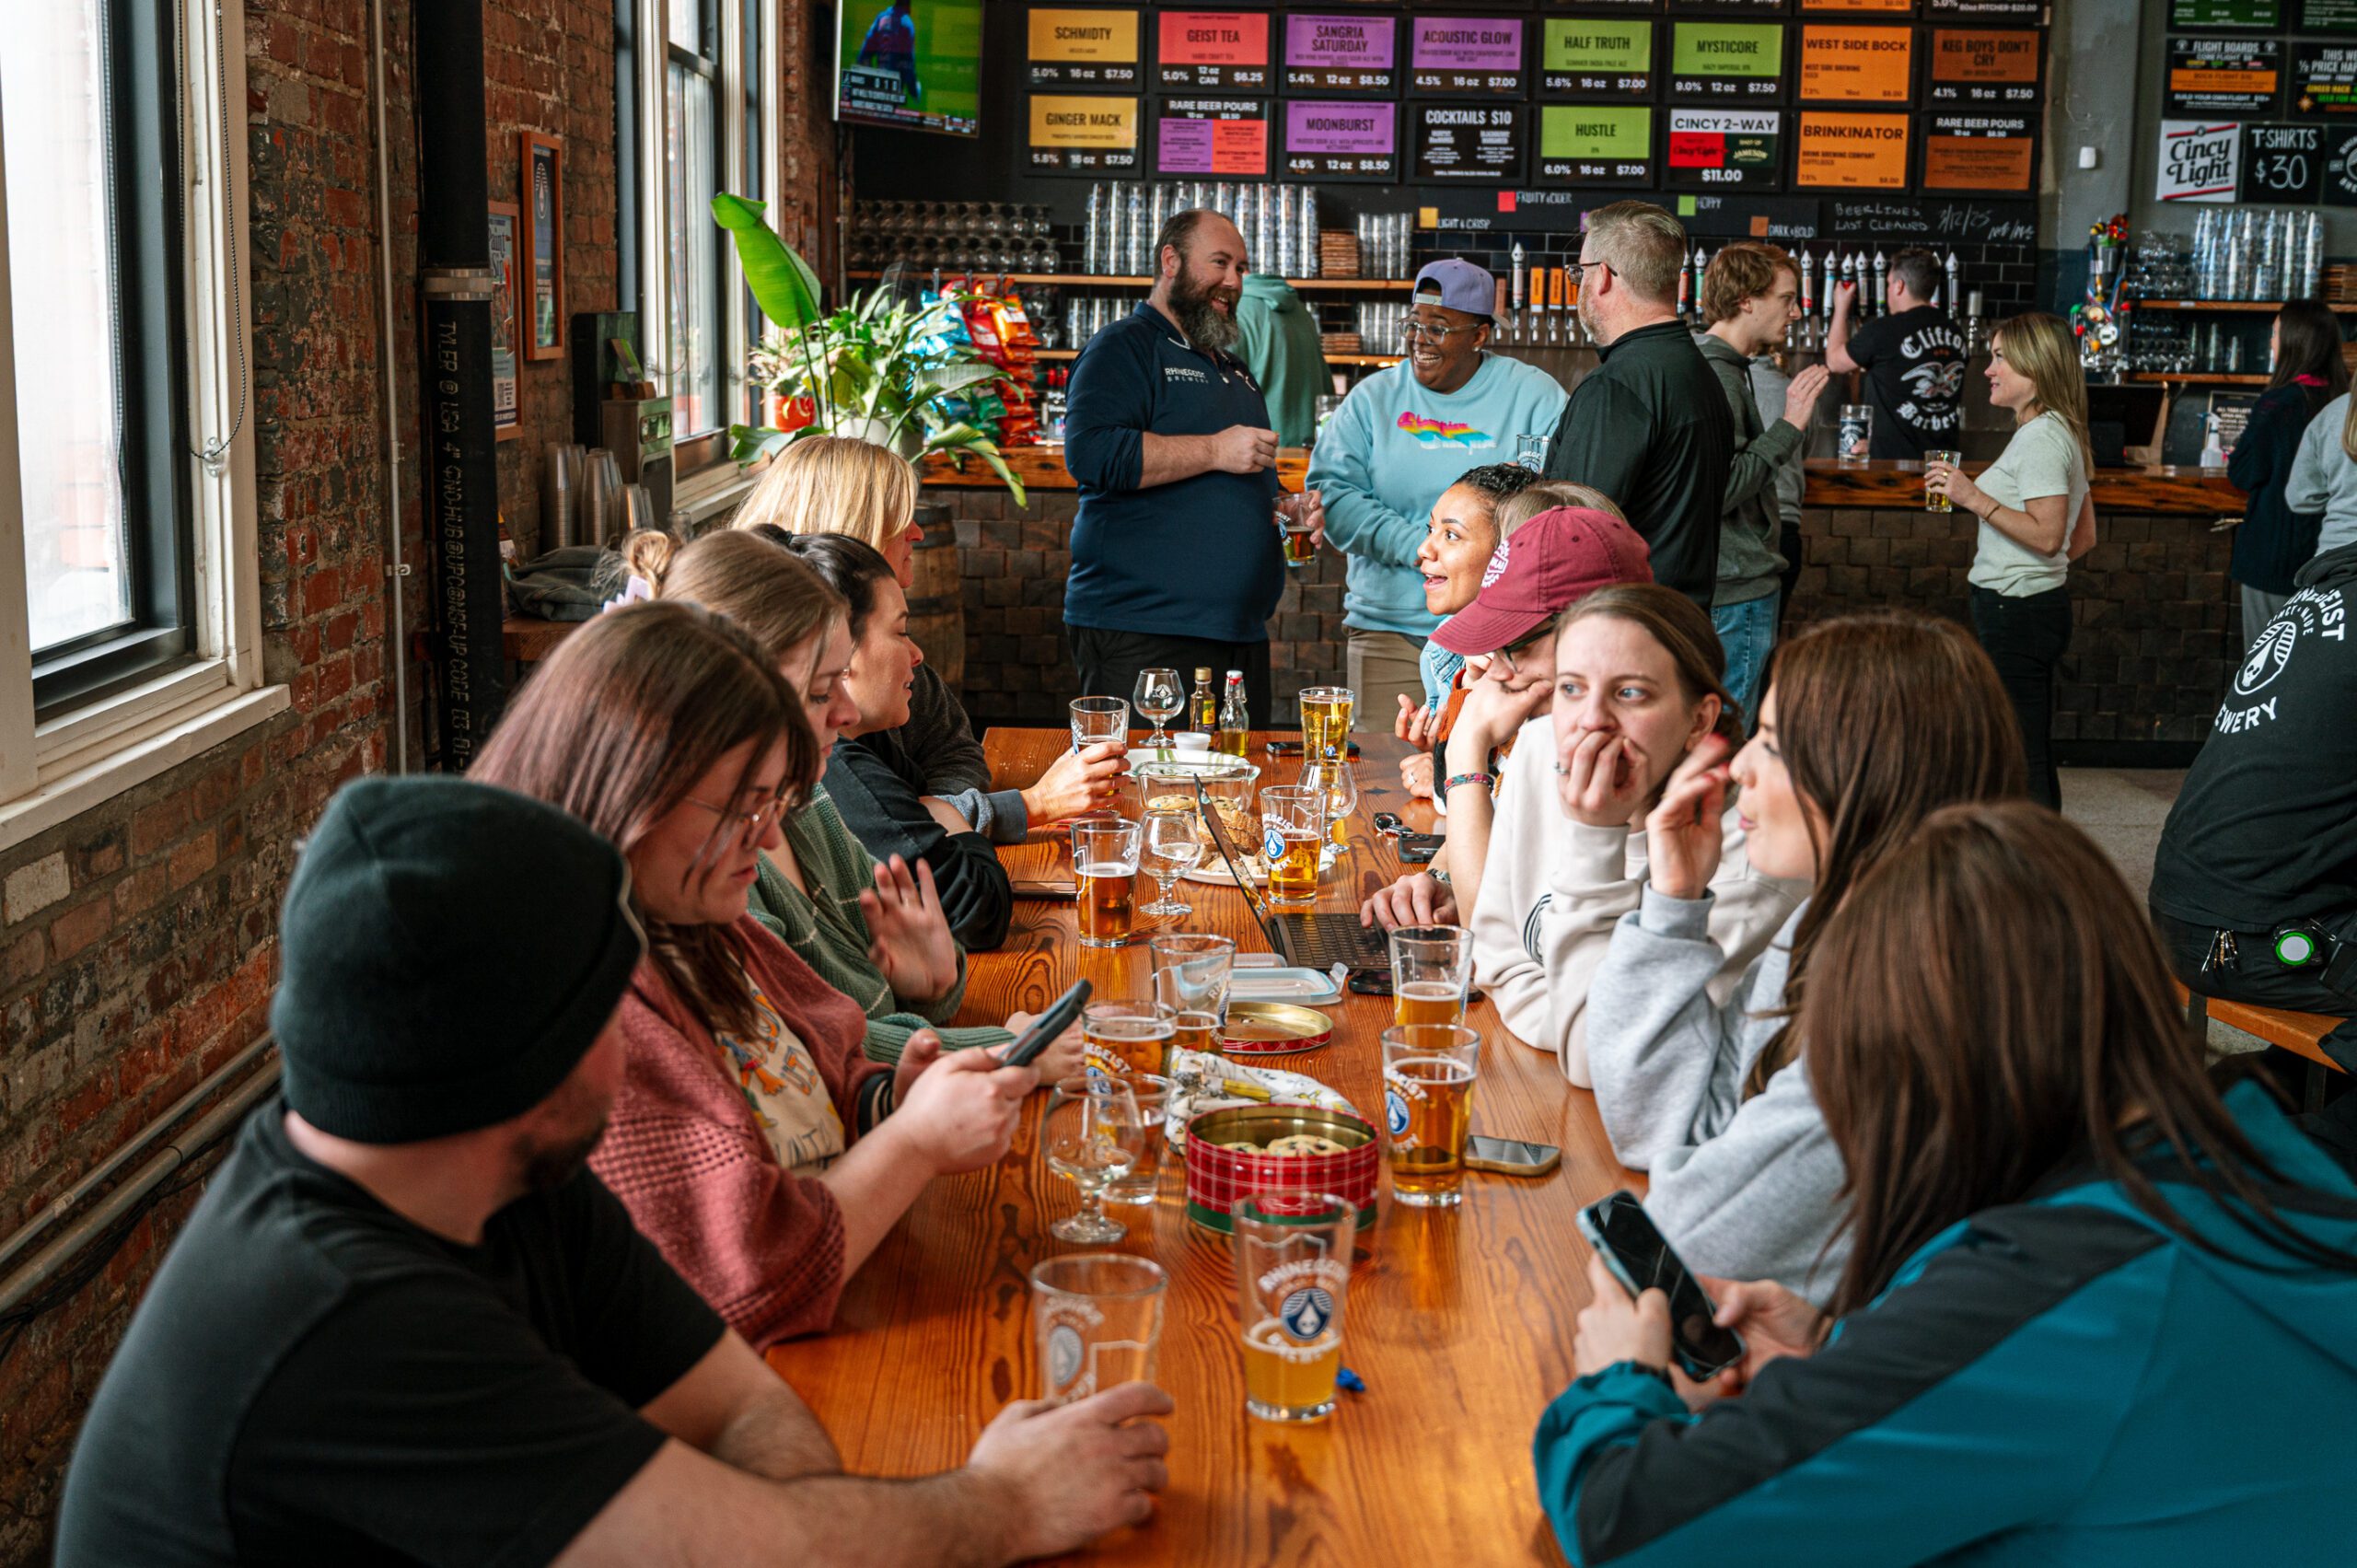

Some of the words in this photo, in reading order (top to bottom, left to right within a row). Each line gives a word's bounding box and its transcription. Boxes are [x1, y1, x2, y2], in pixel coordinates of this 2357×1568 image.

[1055, 27, 1112, 41] SCHMIDTY
[1187, 29, 1217, 43] GEIST
[1221, 30, 1240, 43] TEA
[1317, 25, 1364, 39] SANGRIA
[1422, 30, 1478, 43] ACOUSTIC
[1480, 31, 1513, 45] GLOW
[1312, 39, 1369, 52] SATURDAY
[1564, 36, 1592, 49] HALF
[1596, 37, 1631, 50] TRUTH
[1696, 40, 1759, 54] MYSTICORE
[1806, 39, 1840, 50] WEST
[1842, 40, 1869, 51] SIDE
[1872, 41, 1907, 52] BOCK
[1942, 40, 1963, 52] KEG
[1966, 40, 1995, 52] BOYS
[1998, 41, 2030, 53] DON'T
[2193, 41, 2223, 52] FLIGHT
[2223, 41, 2259, 53] BOARDS
[1974, 53, 1996, 66] CRY
[1031, 67, 1059, 78] 5.0%
[1082, 70, 1096, 79] oz
[1105, 68, 1133, 79] $7.50
[1162, 71, 1190, 81] 5.0%
[1198, 66, 1208, 75] 12
[1208, 67, 1220, 75] oz
[1234, 71, 1263, 82] $6.25
[1199, 75, 1219, 85] CAN
[1288, 73, 1316, 84] 5.4%
[1326, 74, 1338, 84] 12
[1338, 75, 1352, 85] oz
[1359, 75, 1390, 86] $8.50
[1415, 75, 1442, 86] 4.5%
[1453, 76, 1466, 87] 16
[1466, 77, 1480, 87] oz
[1488, 76, 1517, 87] $7.00
[1581, 77, 1593, 88] 16
[1593, 79, 1607, 88] oz
[1618, 78, 1647, 89] $7.00
[1675, 81, 1702, 92] 9.0%
[1711, 82, 1723, 92] 12
[1724, 83, 1737, 93] oz
[1747, 83, 1777, 93] $7.50
[1933, 87, 1957, 99] 4.1%
[1970, 87, 1982, 99] 16
[1983, 89, 1997, 99] oz
[2005, 88, 2034, 99] $7.50
[1169, 100, 1196, 110] RARE
[1197, 101, 1223, 111] BEER
[1224, 101, 1258, 112] POURS
[1046, 112, 1086, 126] GINGER
[1090, 113, 1121, 126] MACK
[1425, 110, 1486, 125] COCKTAILS
[1491, 110, 1513, 125] $10
[1936, 118, 1963, 128] RARE
[1964, 119, 1990, 128] BEER
[1990, 119, 2025, 129] POURS
[1306, 118, 1376, 132] MOONBURST
[1575, 123, 1617, 137] HUSTLE
[1675, 118, 1721, 130] CINCY
[1724, 119, 1775, 131] 2-WAY
[1803, 124, 1904, 140] BRINKINATOR
[2251, 129, 2317, 150] T-SHIRTS
[2169, 137, 2232, 162] Cincy
[1083, 155, 1097, 165] oz
[1105, 155, 1134, 165] $7.50
[1326, 159, 1339, 170] 12
[1340, 161, 1353, 170] oz
[1360, 160, 1390, 171] $8.50
[1544, 164, 1572, 175] 6.0%
[1580, 165, 1592, 175] 16
[1592, 166, 1606, 176] oz
[1616, 165, 1646, 176] $7.00
[1701, 168, 1743, 182] $11.00
[2166, 158, 2231, 188] Light
[1515, 191, 1545, 203] FRUITY
[1697, 196, 1723, 209] HOPPY
[1437, 218, 1459, 229] LIGHT
[1466, 217, 1492, 229] CRISP
[1835, 219, 1864, 231] LAST
[1868, 218, 1930, 232] CLEANED
[1768, 225, 1790, 238] DARK
[1794, 226, 1815, 238] BOLD
[439, 321, 459, 372] TYLER
[449, 659, 470, 703] CODE
[2213, 696, 2277, 734] EWERY
